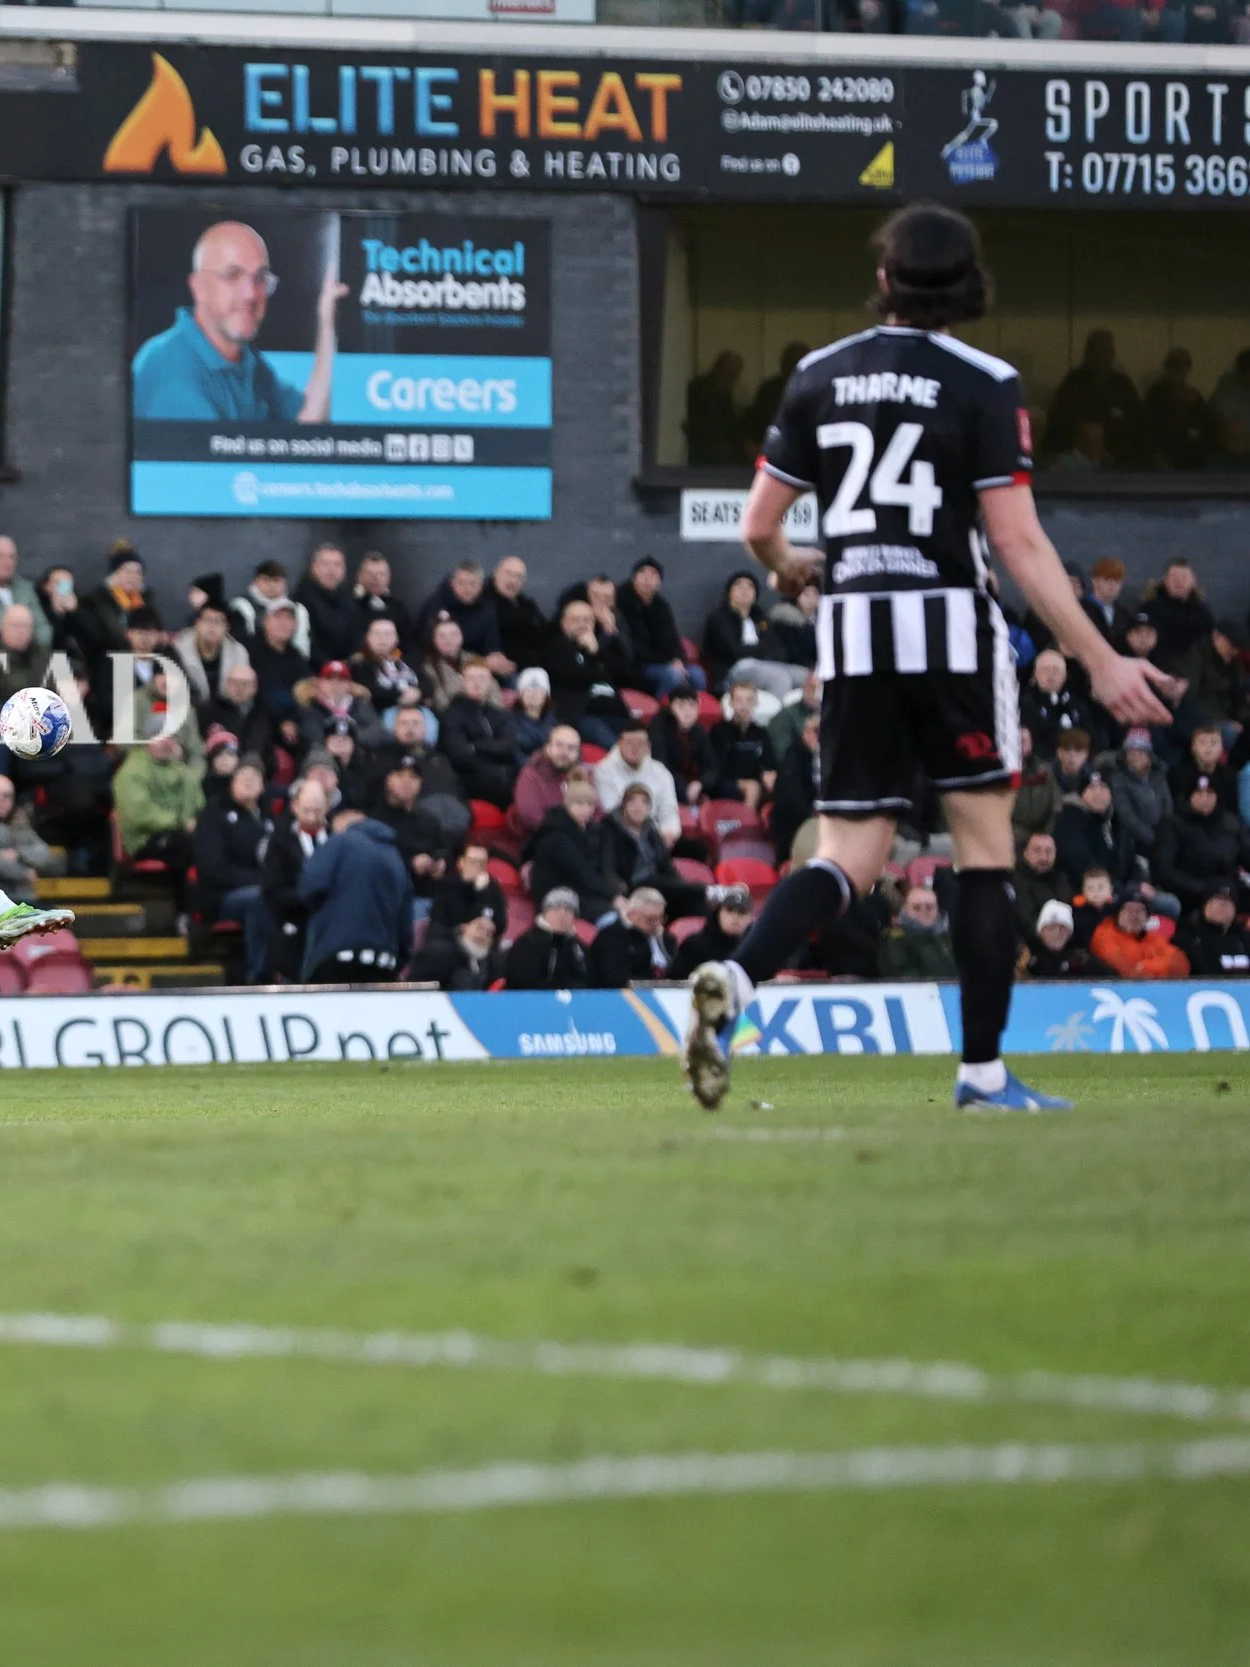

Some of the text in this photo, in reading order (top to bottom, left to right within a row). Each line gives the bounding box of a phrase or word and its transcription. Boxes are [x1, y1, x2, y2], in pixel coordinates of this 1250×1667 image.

[244, 63, 682, 142] ELITE HEAT
[1045, 79, 1250, 146] SPORT
[239, 144, 681, 182] GAS, PLUMBING & HEATING
[1044, 151, 1073, 193] T:
[1082, 151, 1176, 195] 07715
[1184, 154, 1250, 197] 366
[361, 238, 525, 276] Technical
[360, 272, 526, 311] Absorbents
[366, 369, 517, 414] Careers
[832, 371, 942, 408] THARME
[210, 434, 383, 458] Find us on social media
[816, 421, 943, 538] 24
[690, 501, 743, 523] SEATS
[517, 1032, 617, 1056] SAMSUNG
